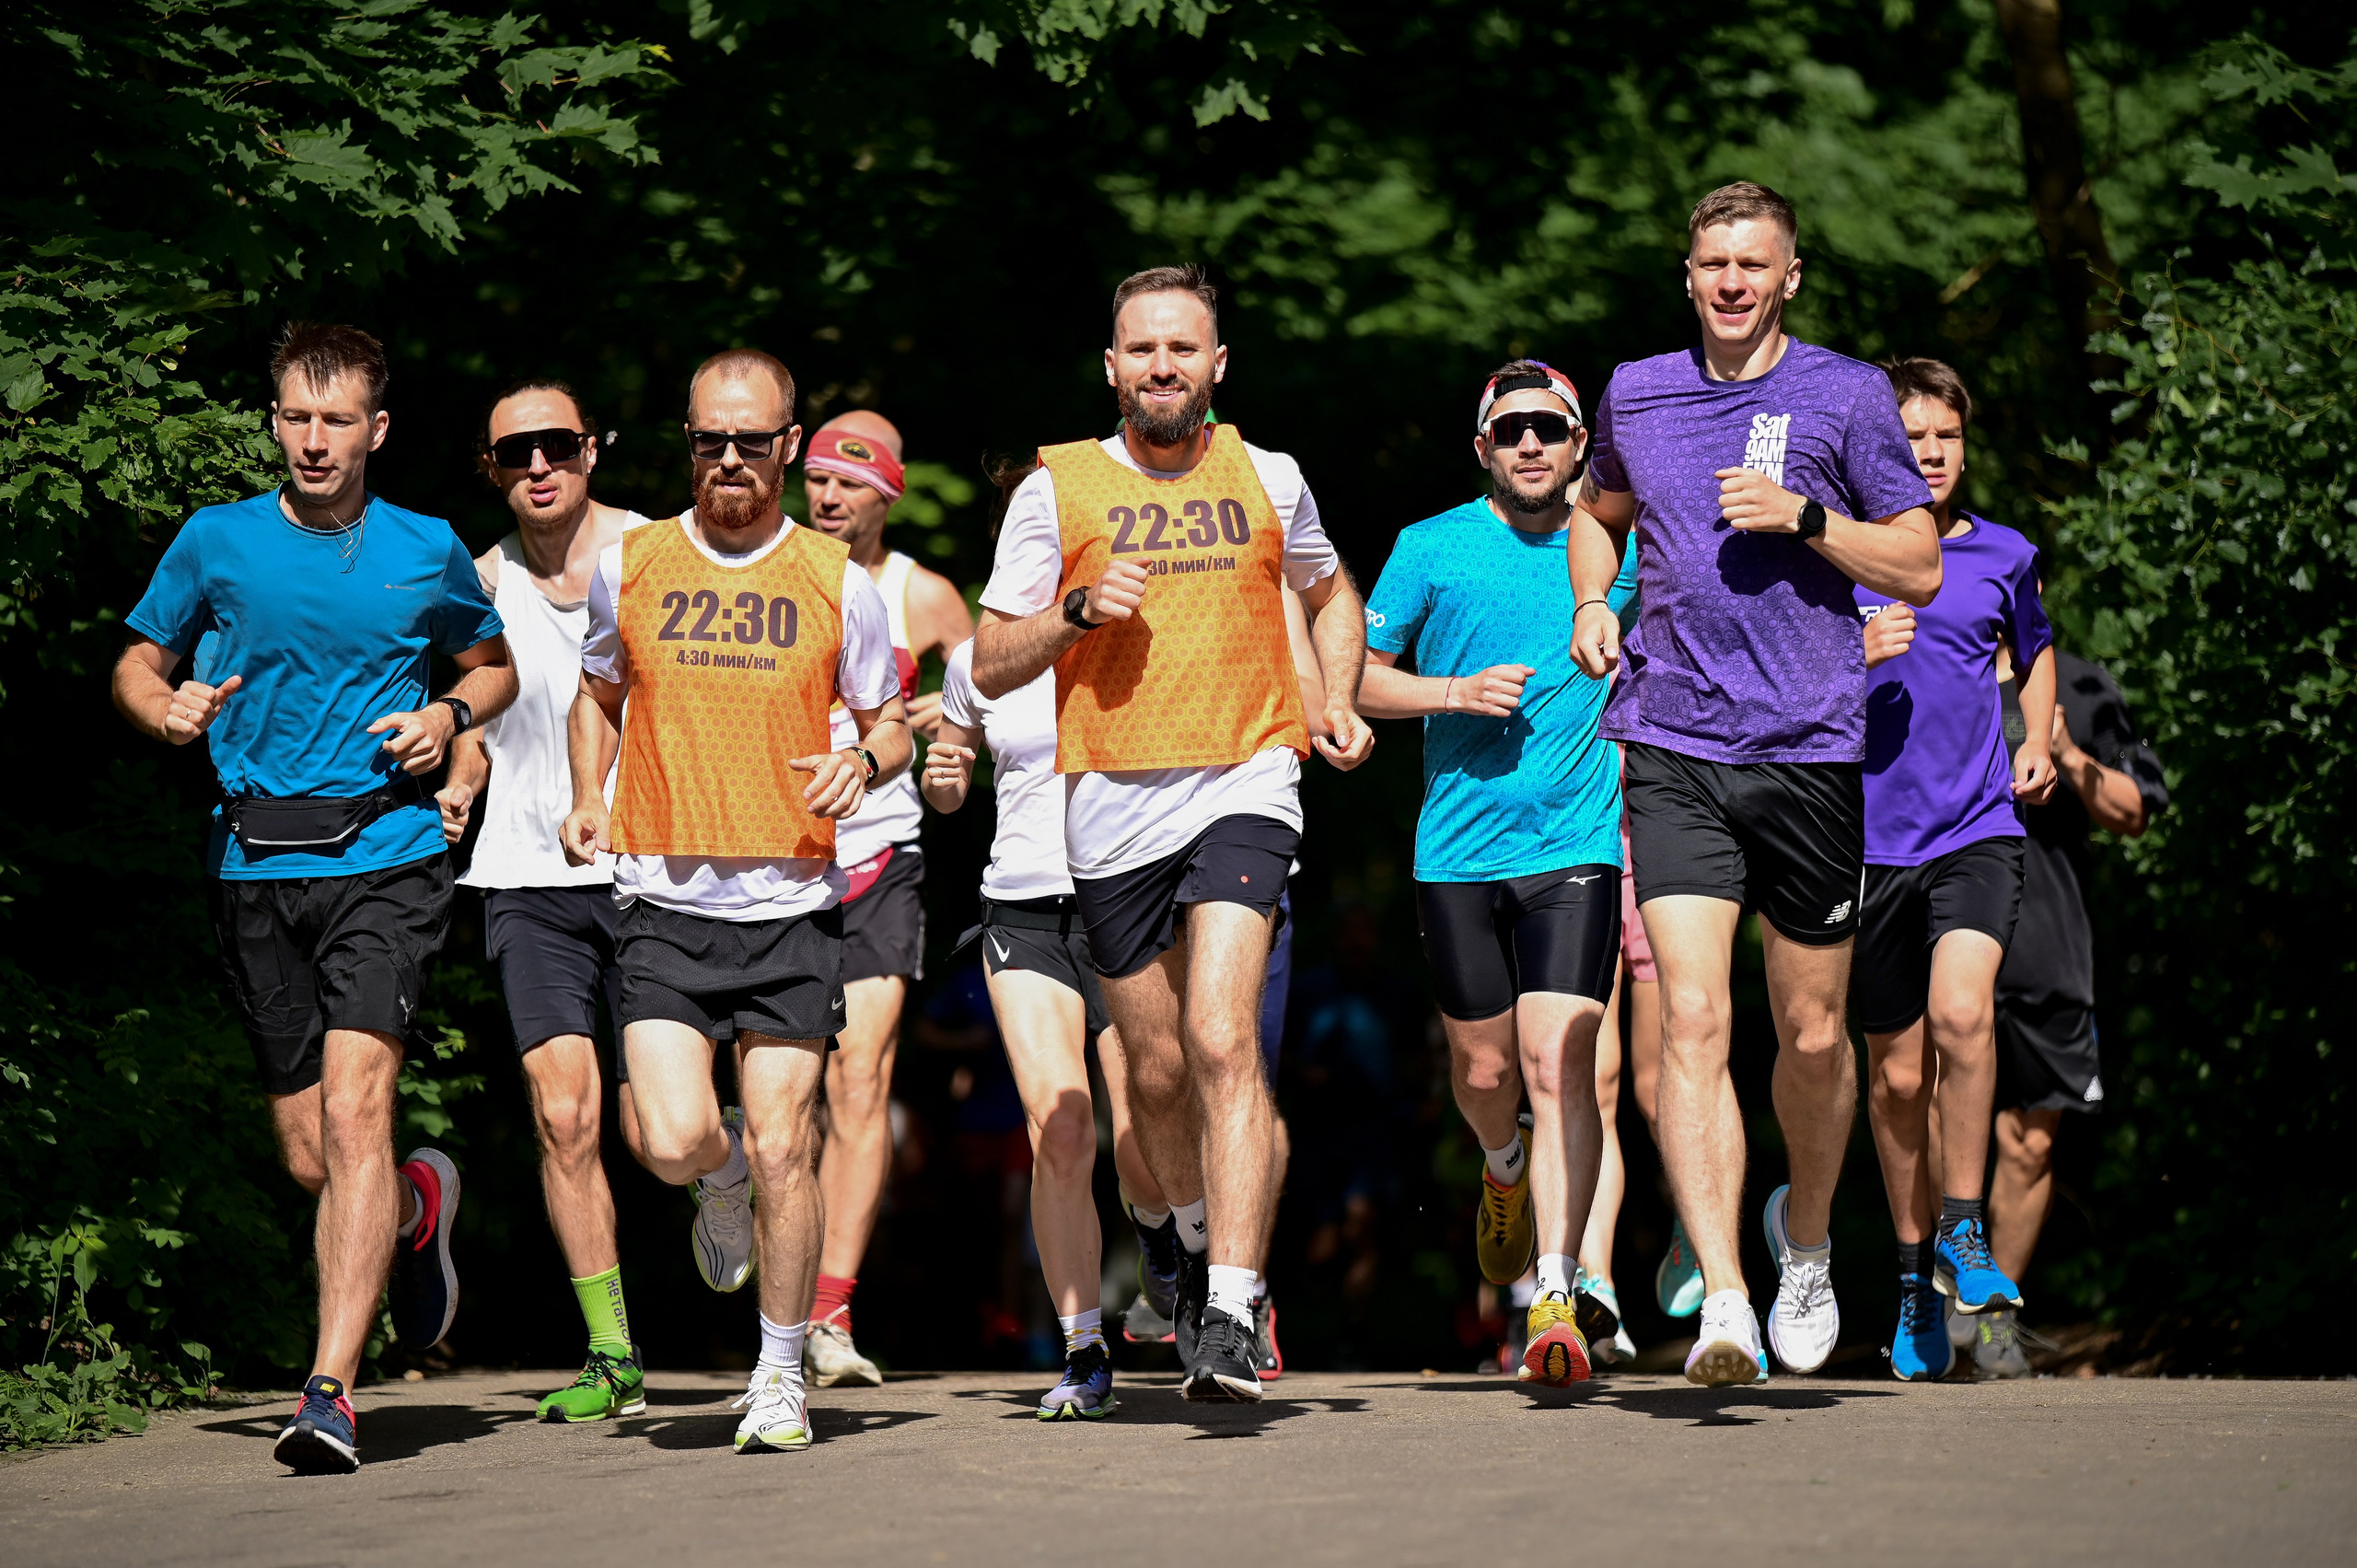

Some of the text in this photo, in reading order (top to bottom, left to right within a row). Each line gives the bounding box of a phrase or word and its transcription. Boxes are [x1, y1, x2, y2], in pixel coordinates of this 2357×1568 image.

[1749, 412, 1792, 440] Sat
[1744, 438, 1787, 463] 9AM
[1107, 498, 1251, 554] 22:30
[1148, 559, 1168, 576] 30
[657, 589, 798, 649] 22:30
[676, 649, 710, 667] 4:30
